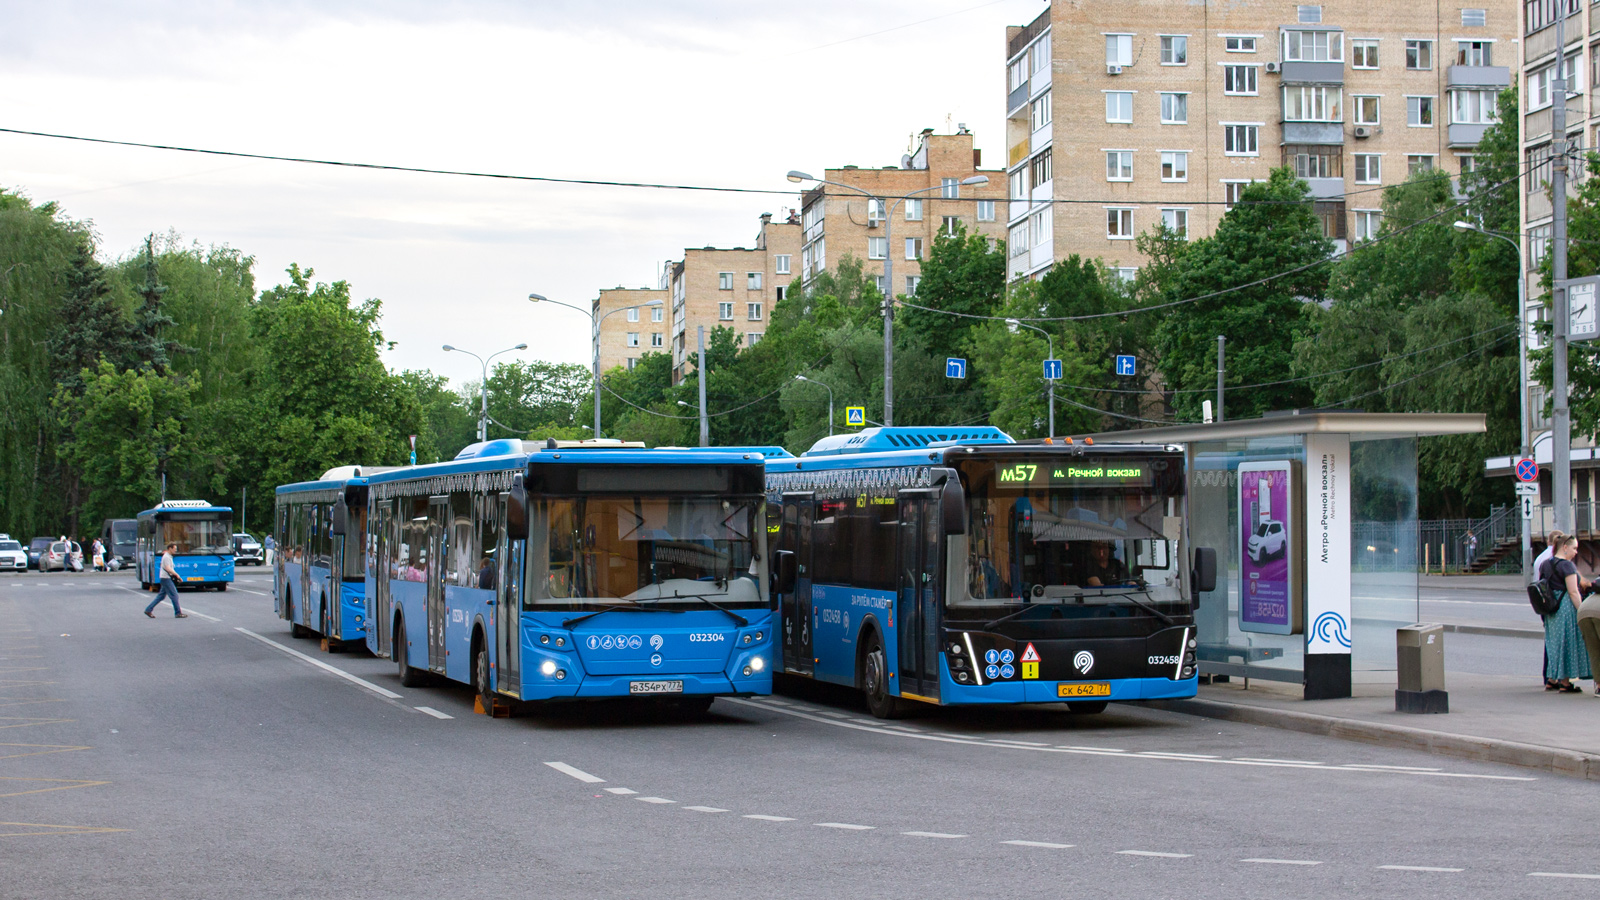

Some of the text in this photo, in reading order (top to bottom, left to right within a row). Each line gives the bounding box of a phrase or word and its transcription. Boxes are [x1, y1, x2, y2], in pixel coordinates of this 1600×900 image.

[1068, 467, 1103, 478] Речной
[1107, 469, 1141, 477] вокзал
[1321, 532, 1329, 563] Метро
[823, 608, 841, 624] 032458
[689, 633, 725, 642] 032304
[1148, 655, 1180, 664] 032458
[1076, 685, 1094, 695] 642
[1099, 684, 1108, 692] 77
